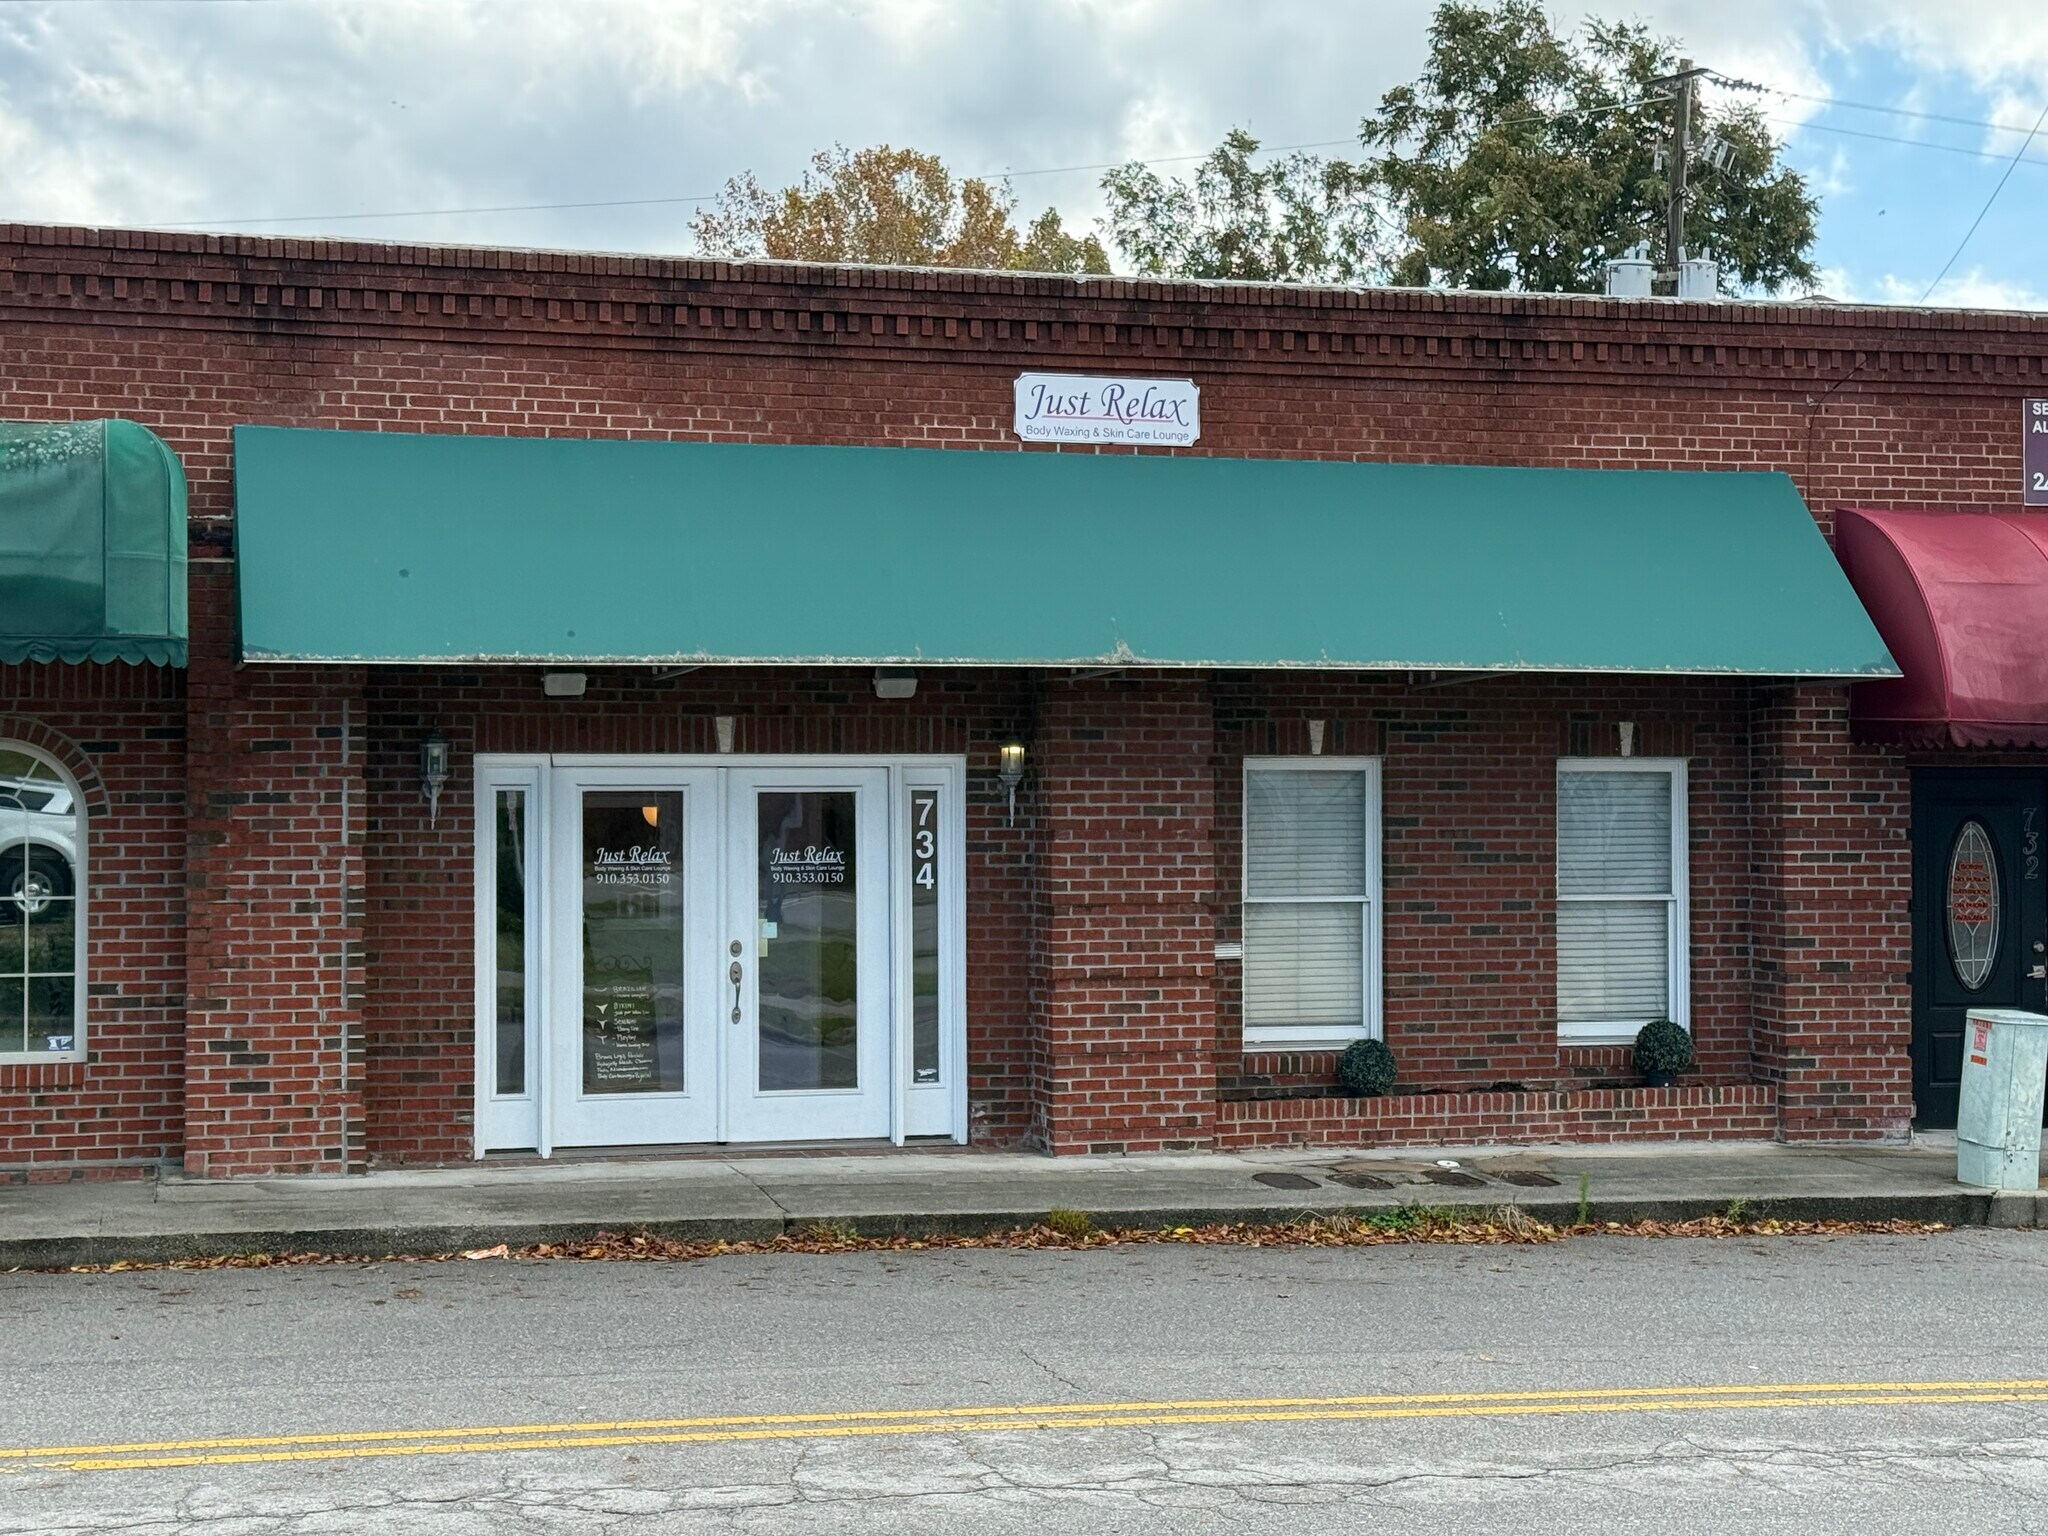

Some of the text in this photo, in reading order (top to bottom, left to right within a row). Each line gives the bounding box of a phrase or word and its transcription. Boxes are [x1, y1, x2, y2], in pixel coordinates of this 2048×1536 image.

[1024, 383, 1190, 427] Just Relax
[1026, 424, 1190, 442] Body Waxing & Skin Care Lounge
[915, 799, 935, 890] 734
[593, 845, 671, 865] Just Relax
[770, 846, 846, 865] Just Relax
[596, 873, 669, 884] 910.353.0150
[773, 872, 844, 884] 910.353.0150
